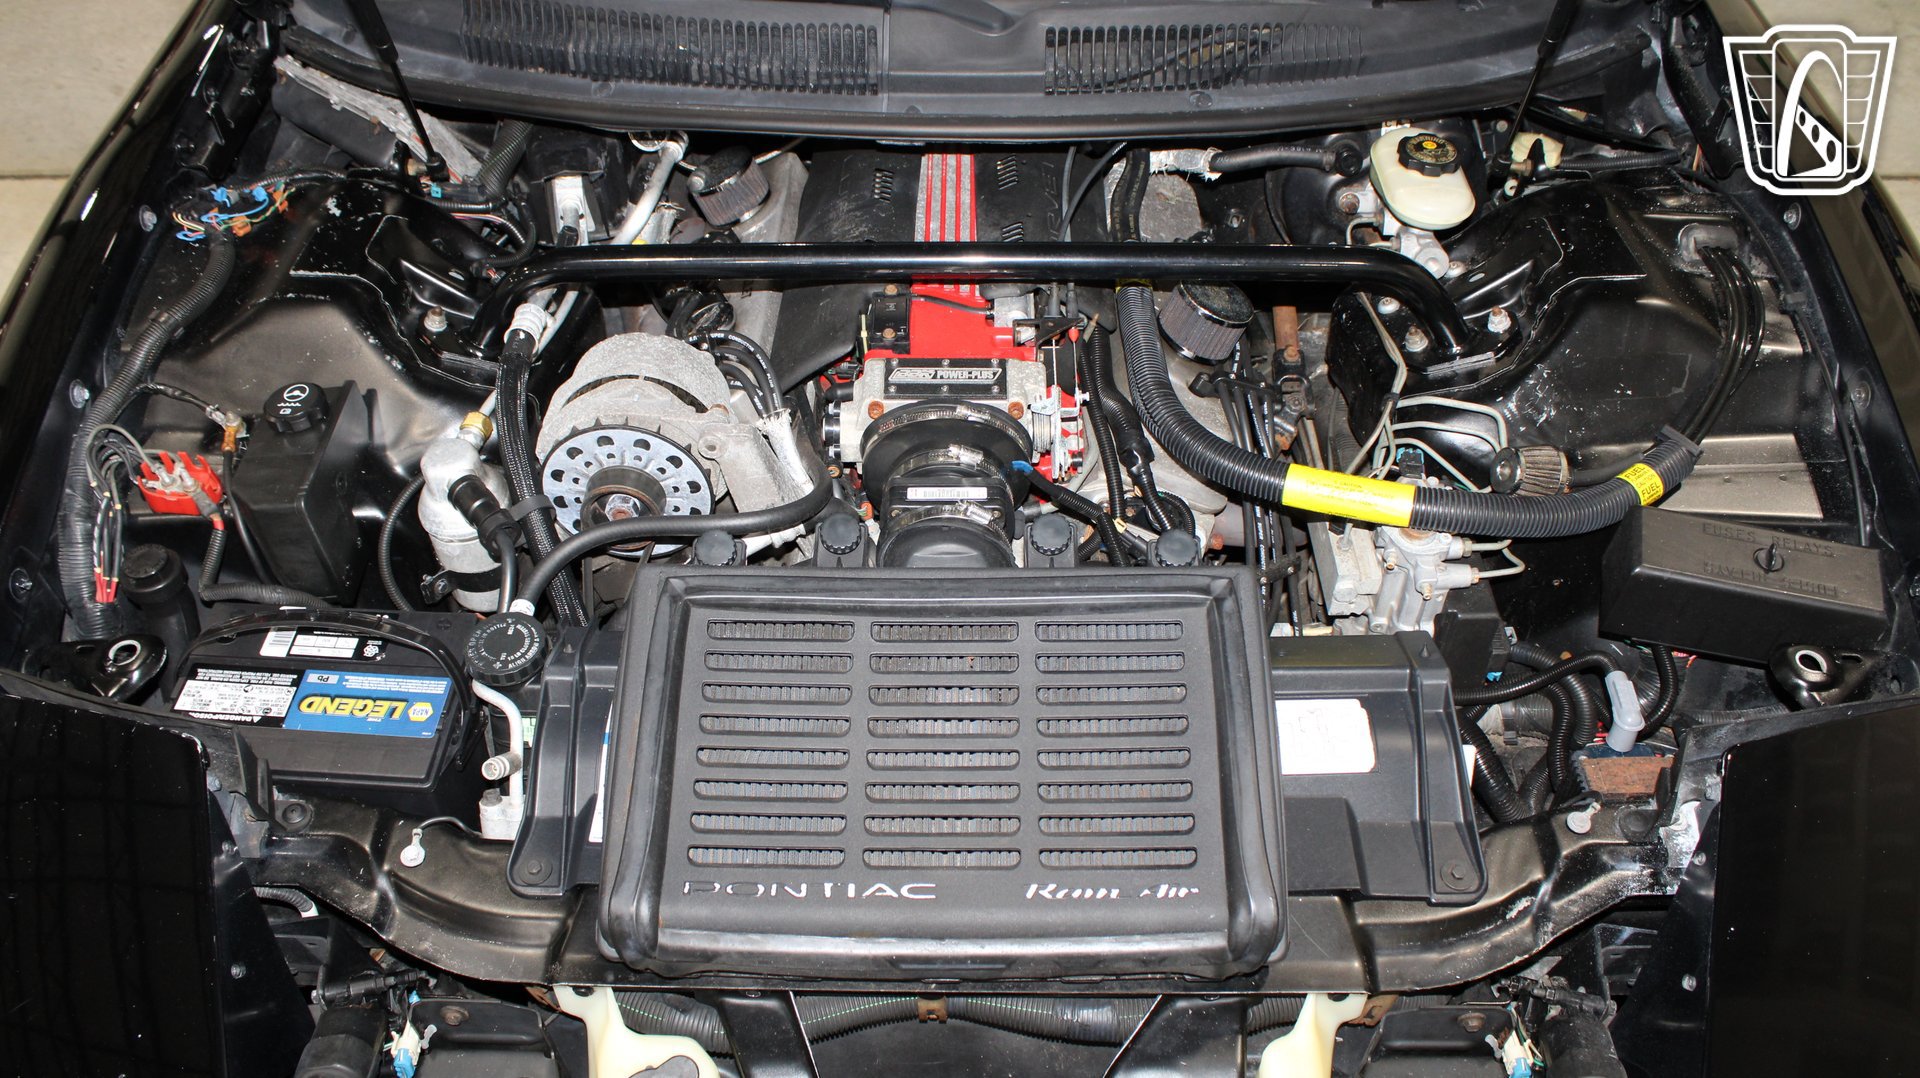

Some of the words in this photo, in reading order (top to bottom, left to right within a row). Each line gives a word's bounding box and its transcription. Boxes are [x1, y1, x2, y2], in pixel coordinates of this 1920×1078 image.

[936, 369, 994, 381] POWER-PLUS
[1625, 467, 1645, 479] FUEL
[1642, 482, 1660, 498] FUEL
[1771, 535, 1835, 559] RELAYS
[508, 656, 526, 669] ALIGN
[317, 675, 330, 683] Pb
[299, 694, 409, 719] LEGEND
[411, 706, 430, 716] NAPA
[683, 881, 937, 900] PONTIAC
